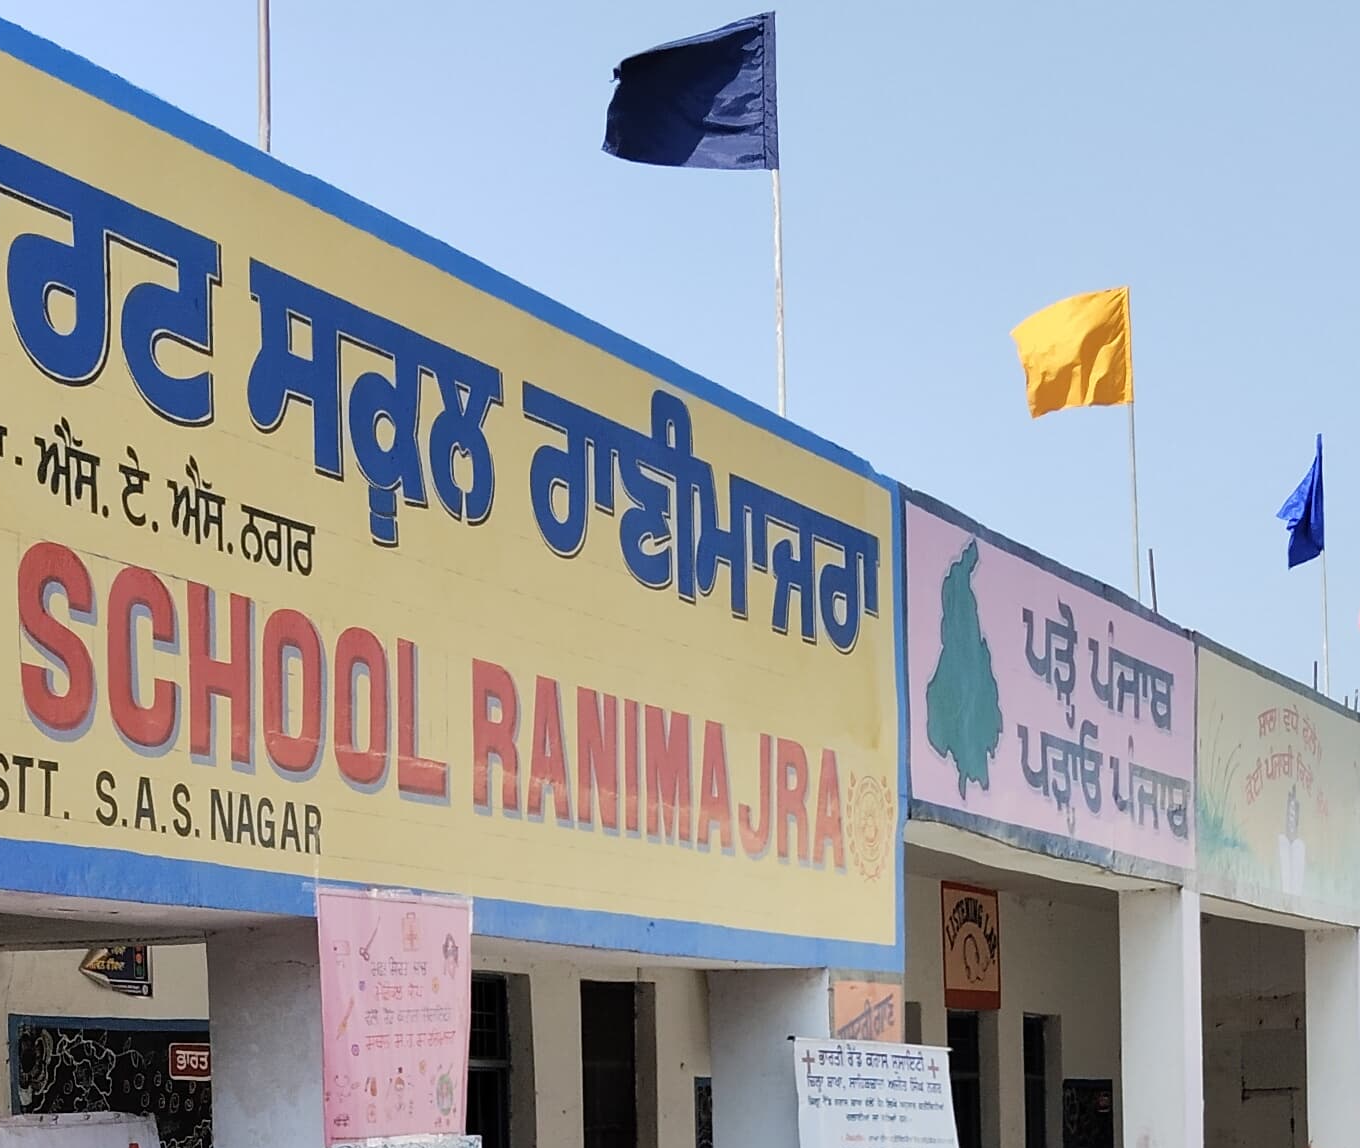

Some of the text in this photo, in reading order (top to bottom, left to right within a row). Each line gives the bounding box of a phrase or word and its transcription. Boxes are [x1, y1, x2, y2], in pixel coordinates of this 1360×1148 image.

[246, 258, 504, 547] ਸਕੂਲ
[520, 388, 882, 655] ਰਾਣੀਮਾਜਰਾ
[240, 503, 316, 577] ਨਗਰ
[17, 541, 449, 809] SCHOOL
[470, 659, 847, 879] RANIMAJRA
[1087, 619, 1175, 732] ਪੰਜਾਬ
[1109, 734, 1192, 840] ਪੰਜਾਬ
[175, 1049, 210, 1071] ਭਾਰਤ
